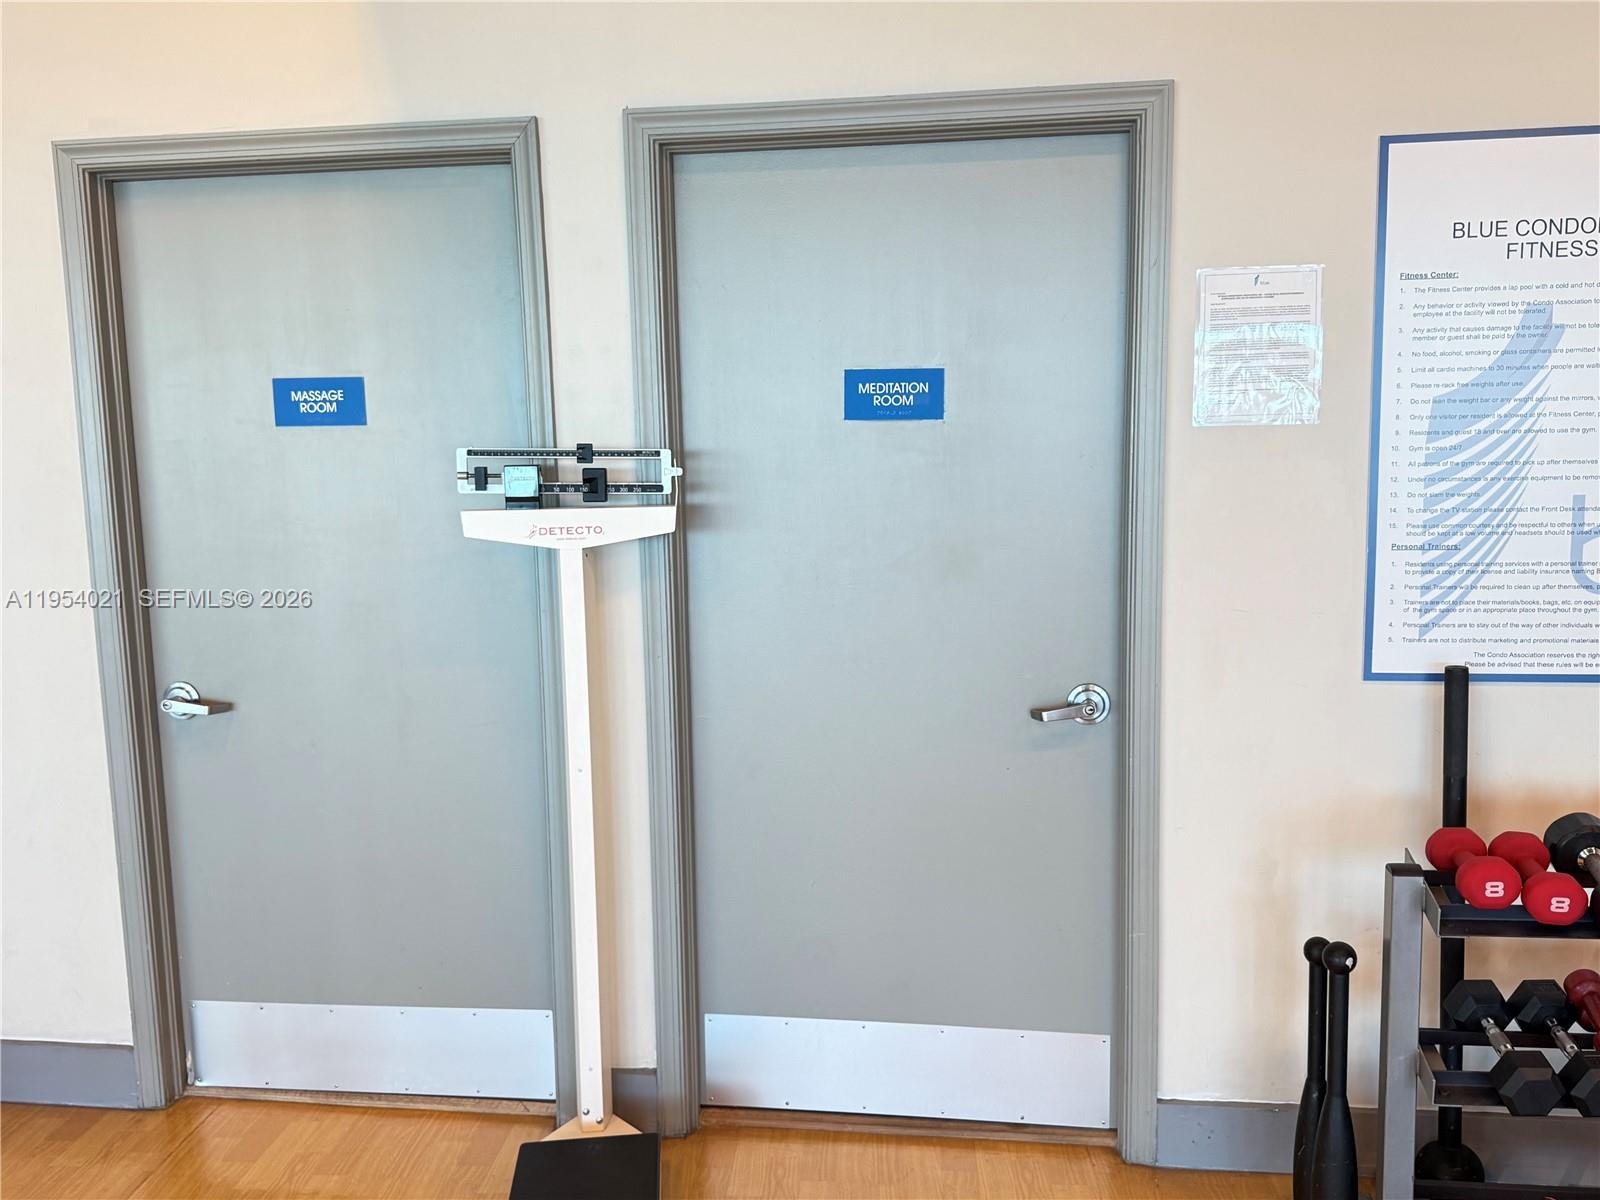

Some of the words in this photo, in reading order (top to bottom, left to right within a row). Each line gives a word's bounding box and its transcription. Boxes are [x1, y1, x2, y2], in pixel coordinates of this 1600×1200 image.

[1453, 220, 1508, 239] BLUE
[1515, 216, 1600, 237] CONDO
[1506, 240, 1599, 260] FITNESS
[1400, 272, 1428, 280] Fitness
[1430, 271, 1459, 279] Center:
[1428, 285, 1450, 293] Fitness
[1475, 284, 1500, 293] provides
[1520, 283, 1533, 291] pool
[1413, 302, 1424, 311] Any
[1428, 301, 1454, 309] behavior
[1464, 300, 1485, 309] activity
[1556, 297, 1592, 305] Association
[1413, 310, 1443, 318] employee
[1413, 326, 1425, 335] Any
[1426, 326, 1447, 334] activity
[1487, 324, 1511, 333] damage
[1448, 333, 1464, 342] guest
[1492, 332, 1505, 340] paid
[1465, 348, 1491, 357] smoking
[1501, 348, 1517, 356] glass
[1566, 345, 1595, 354] permitted
[1551, 362, 1572, 371] people
[858, 382, 929, 393] MEDITATION
[291, 390, 344, 401] MASSAGE
[873, 395, 914, 406] ROOM
[300, 402, 337, 413] ROOM
[1410, 413, 1423, 421] Only
[1455, 428, 1472, 436] guest
[1409, 445, 1423, 453] Gym
[1432, 445, 1447, 453] open
[1488, 459, 1513, 467] required
[1530, 474, 1563, 482] equipment
[1519, 521, 1548, 529] respectful
[538, 525, 603, 536] DETECTO
[1436, 560, 1452, 569] using
[1454, 560, 1479, 568] personal
[1550, 560, 1576, 568] personal
[1412, 568, 1434, 576] provide
[1517, 568, 1537, 576] liability
[1572, 568, 1594, 576] naming
[1480, 583, 1504, 591] required
[1460, 599, 1475, 607] place
[1543, 599, 1559, 607] bags,
[1483, 606, 1517, 614] appropriate
[1519, 606, 1535, 614] place
[1537, 606, 1570, 614] throughout
[1477, 621, 1489, 630] stay
[1488, 637, 1518, 645] marketing
[1533, 637, 1568, 645] promotional
[1485, 882, 1504, 898] 8
[1550, 897, 1570, 913] 8
